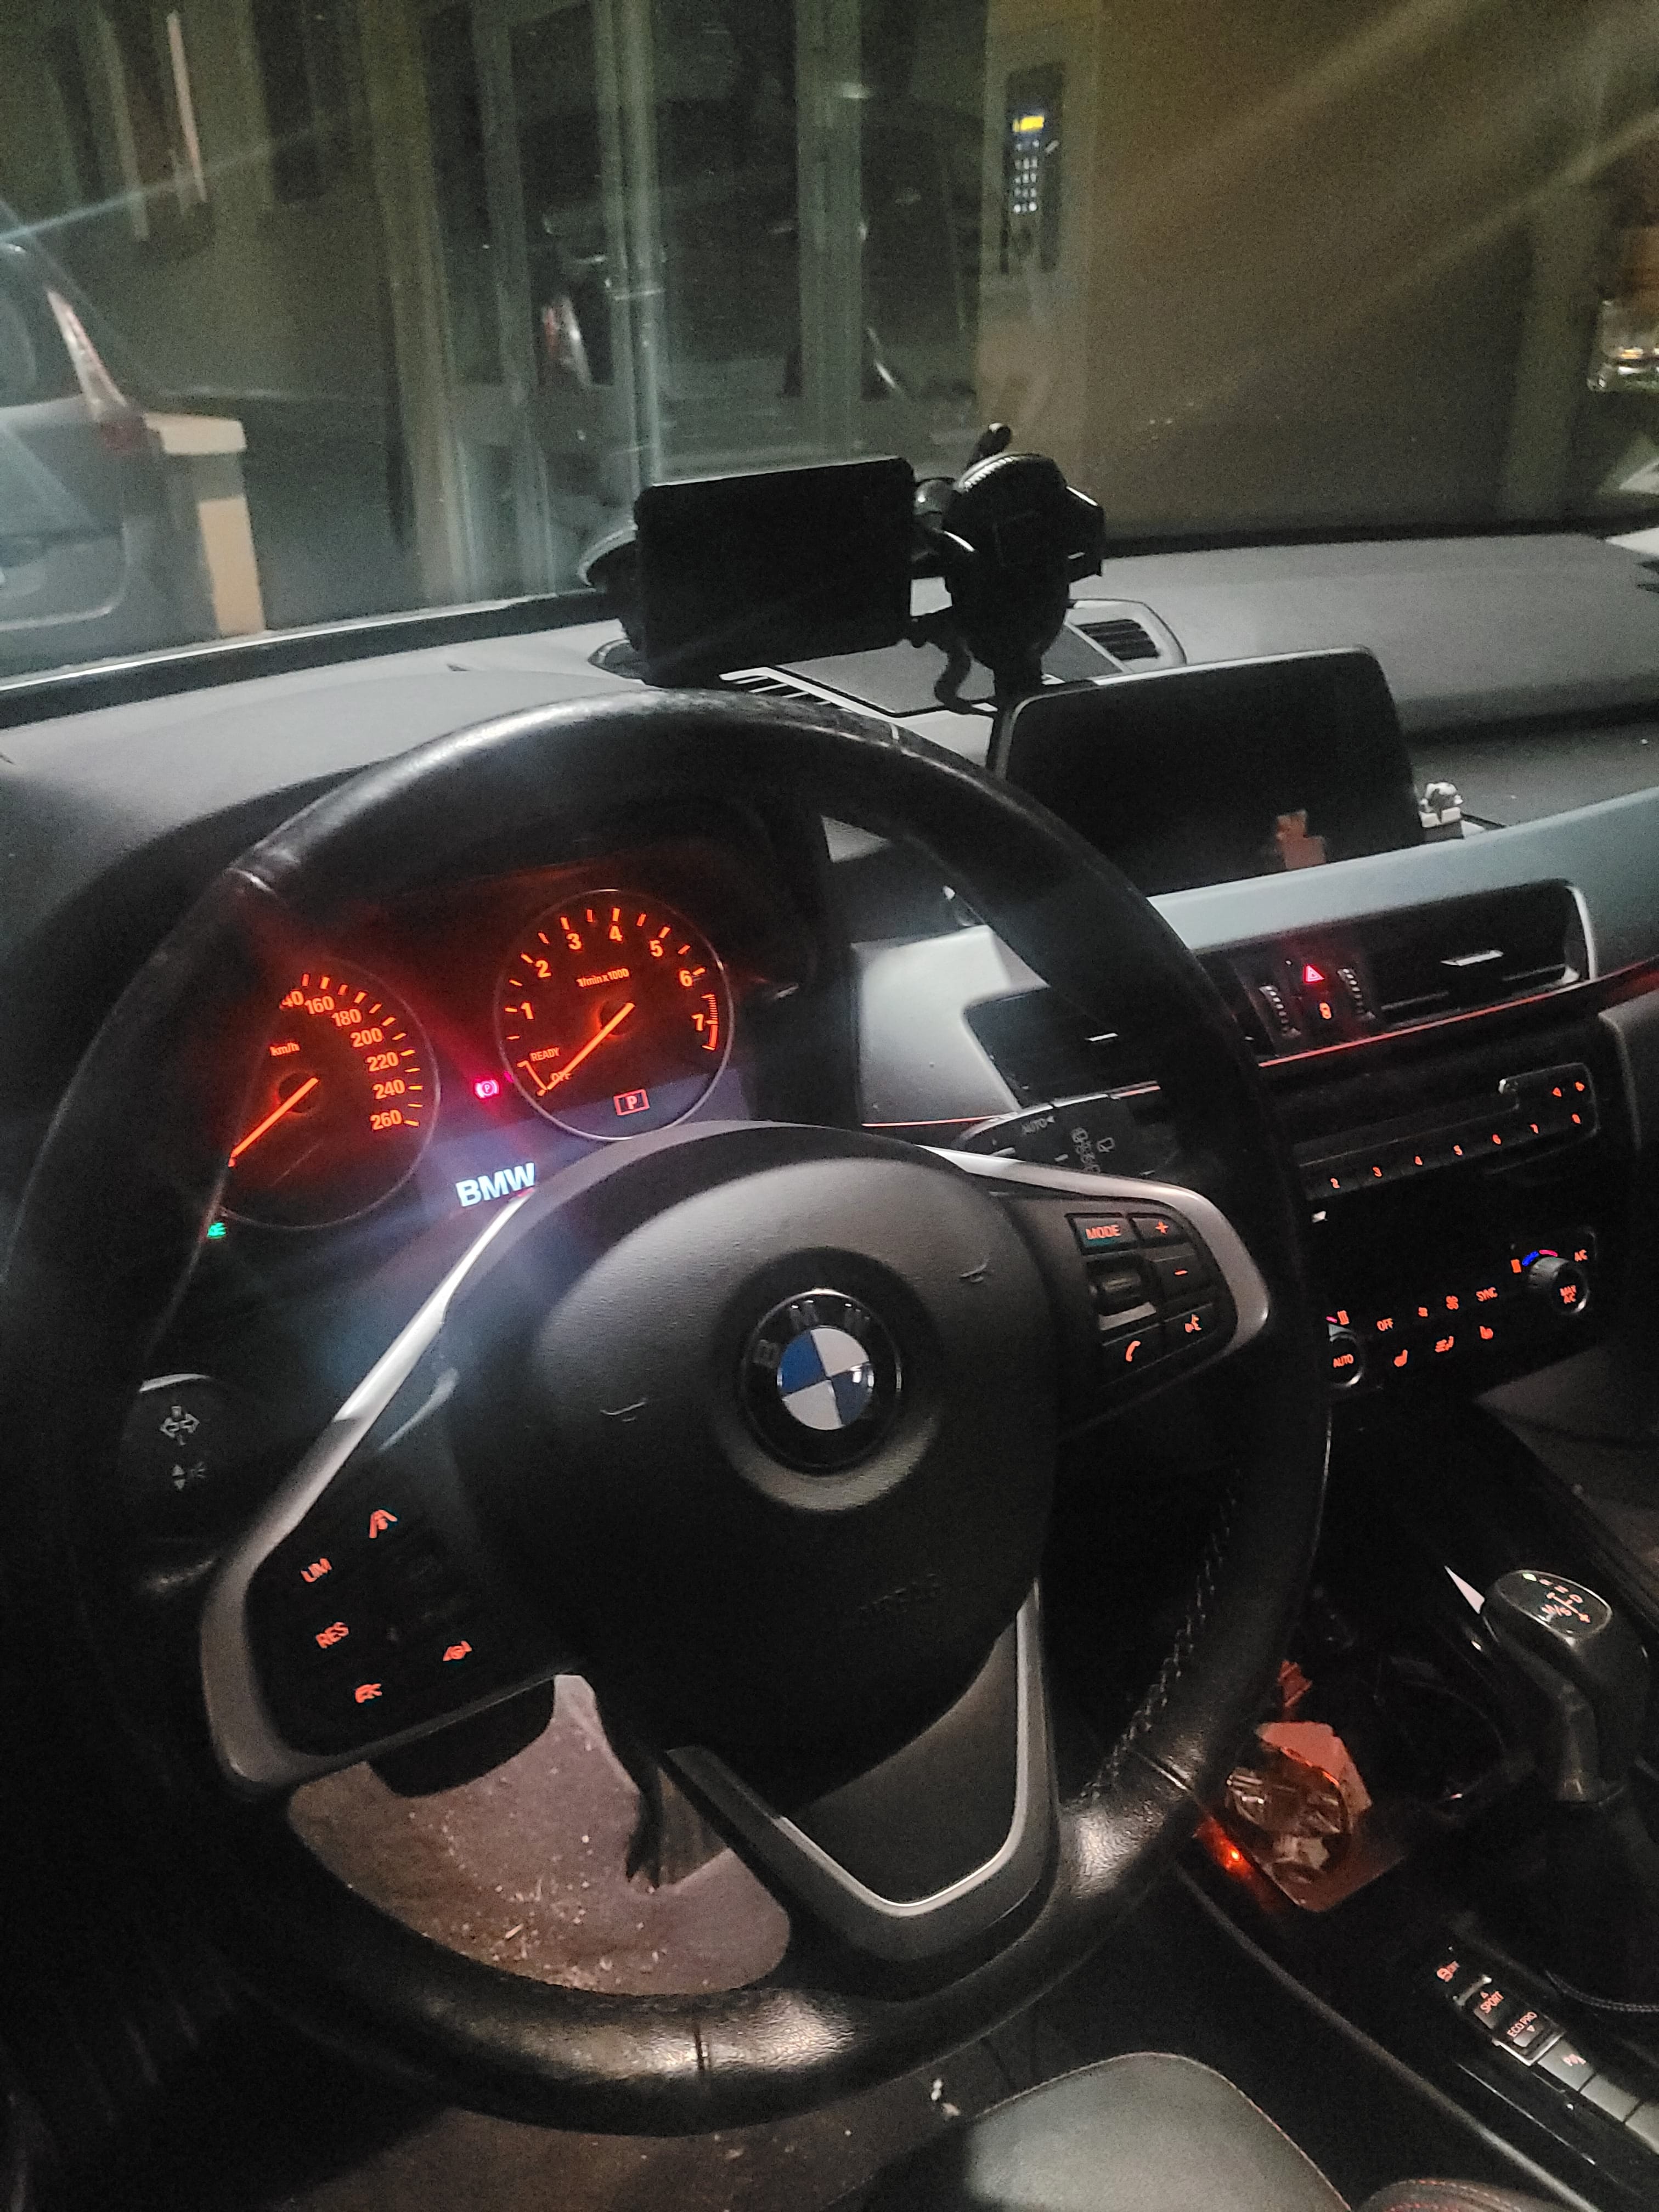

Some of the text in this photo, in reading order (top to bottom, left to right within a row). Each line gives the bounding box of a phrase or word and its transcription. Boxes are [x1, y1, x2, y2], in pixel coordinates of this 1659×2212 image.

[566, 933, 582, 950] 3
[608, 924, 624, 942] 4
[650, 940, 664, 957] 5
[534, 960, 551, 978] 2
[679, 969, 694, 988] 6
[279, 990, 304, 1011] 40
[304, 996, 335, 1014] 160
[331, 1008, 363, 1028] 180
[521, 1002, 535, 1020] 1
[691, 1013, 705, 1032] 7
[351, 1027, 383, 1048] 200
[269, 1041, 301, 1057] km/h
[529, 1047, 560, 1062] READY
[366, 1051, 399, 1072] 220
[373, 1079, 406, 1099] 240
[626, 1096, 637, 1110] P
[369, 1109, 403, 1131] 260
[455, 1162, 535, 1207] BMW
[1330, 1178, 1340, 1188] 2
[1085, 1224, 1122, 1240] MODE
[1476, 1287, 1498, 1301] SYNC
[1376, 1318, 1393, 1331] OFF
[1333, 1353, 1354, 1368] AUTO
[1480, 1991, 1504, 2014] SPORT
[1506, 2011, 1538, 2038] ECO PRO
